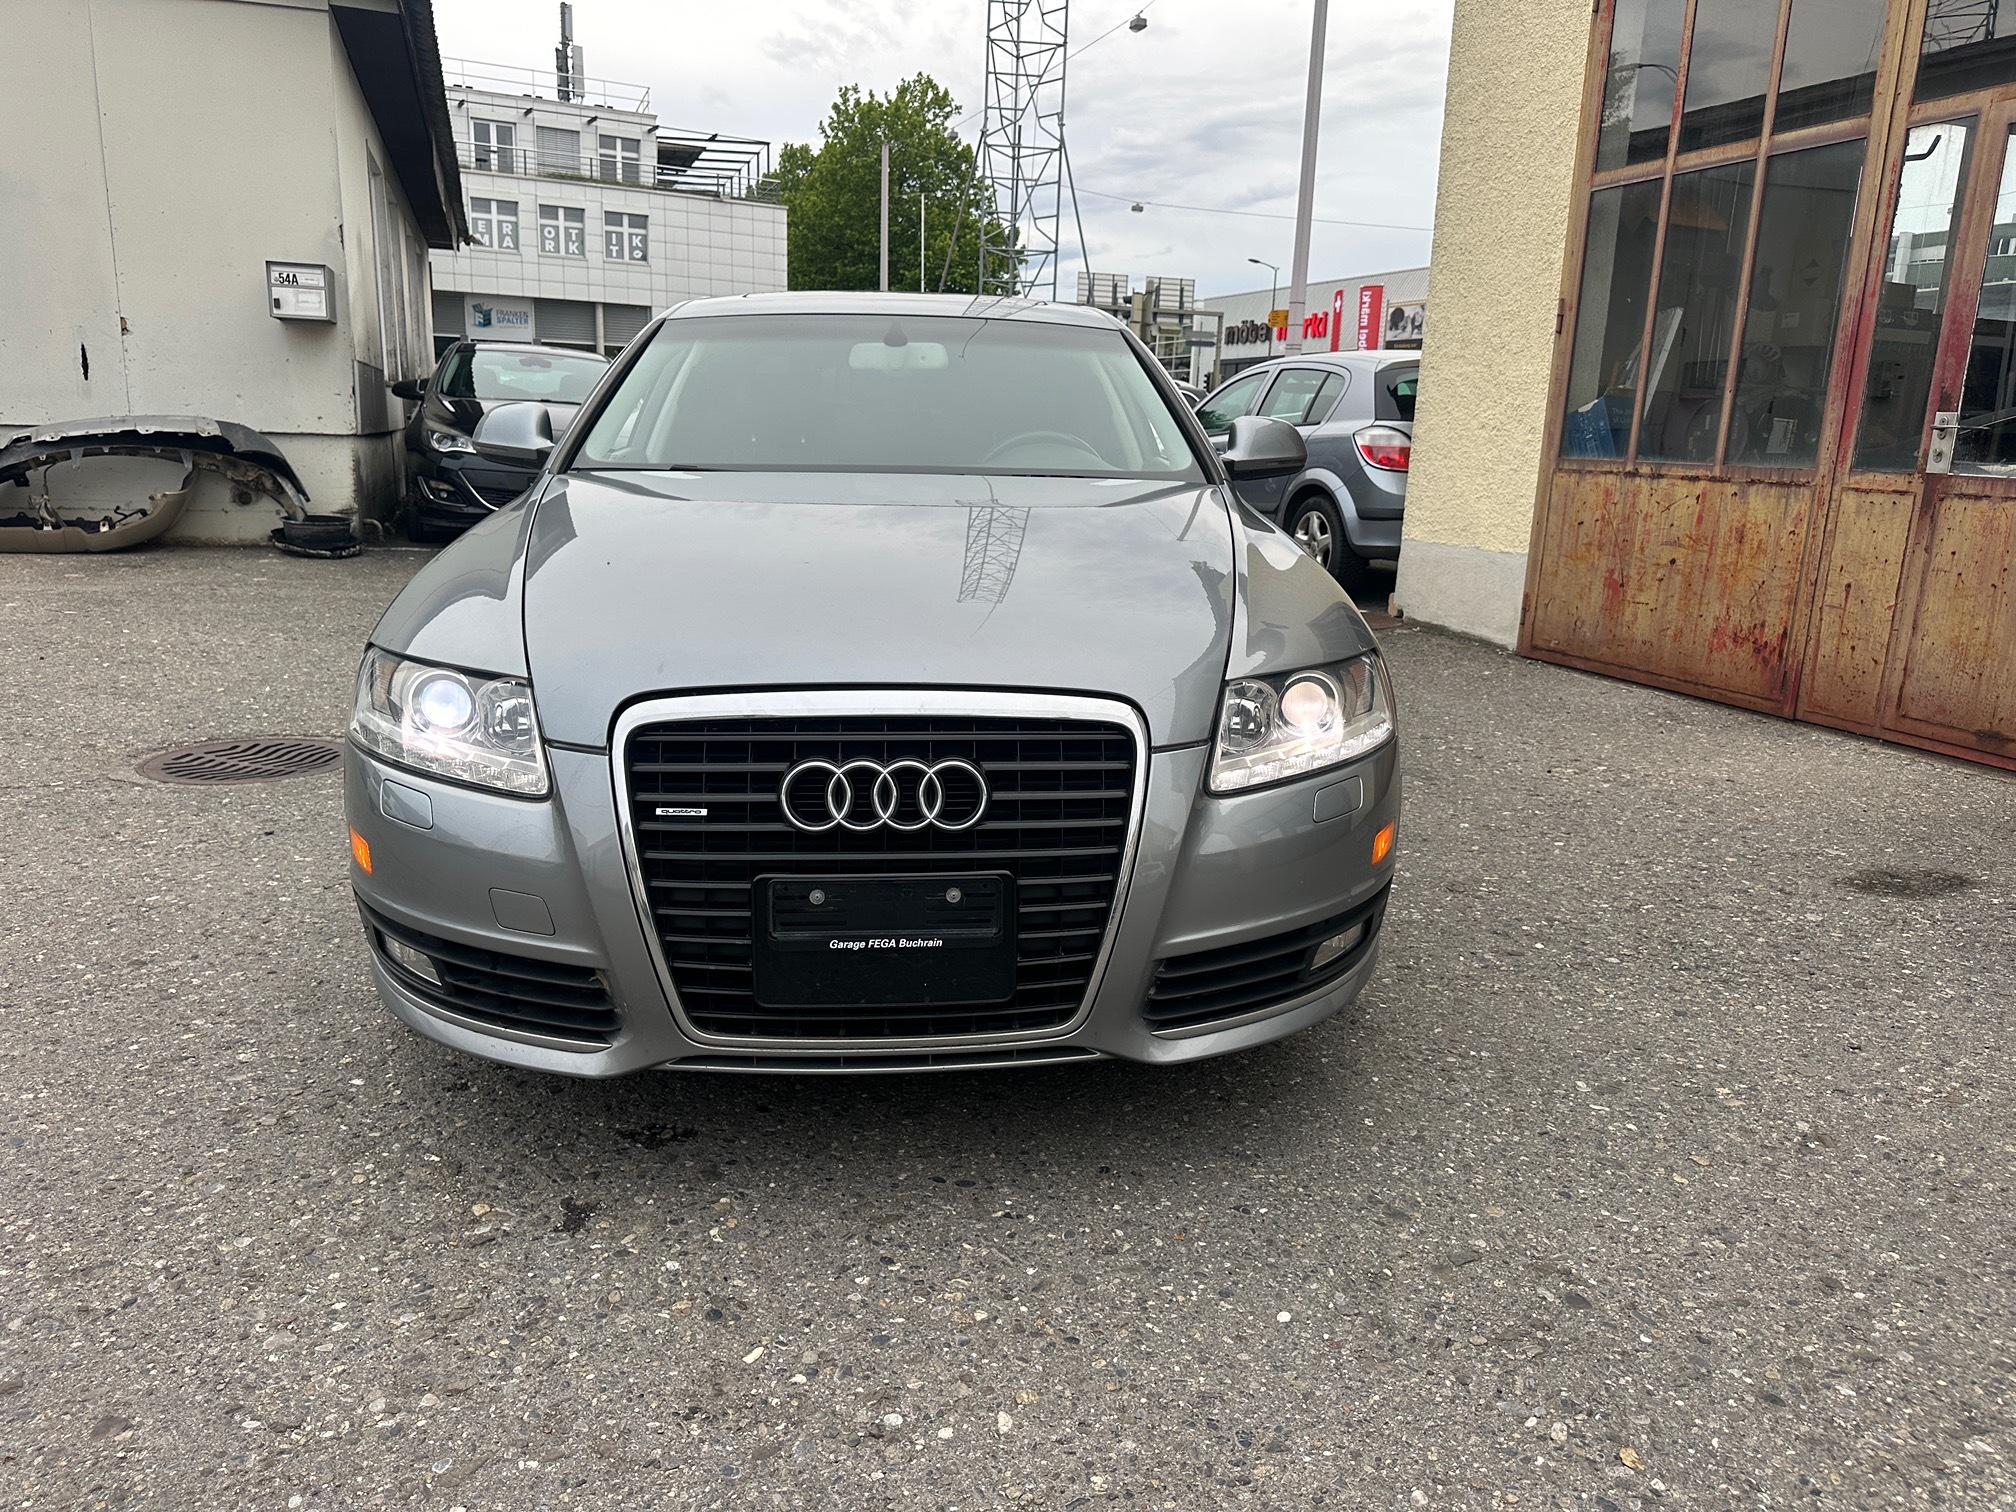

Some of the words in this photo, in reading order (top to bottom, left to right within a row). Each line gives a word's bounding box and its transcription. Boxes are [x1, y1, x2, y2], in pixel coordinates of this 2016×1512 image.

[278, 272, 299, 285] 54A
[496, 309, 529, 317] FRANKEN
[496, 316, 529, 325] SPALTER
[1224, 319, 1272, 345] möbe
[829, 939, 866, 950] Garage
[868, 938, 896, 949] FEGA
[898, 937, 943, 948] Buchrain
